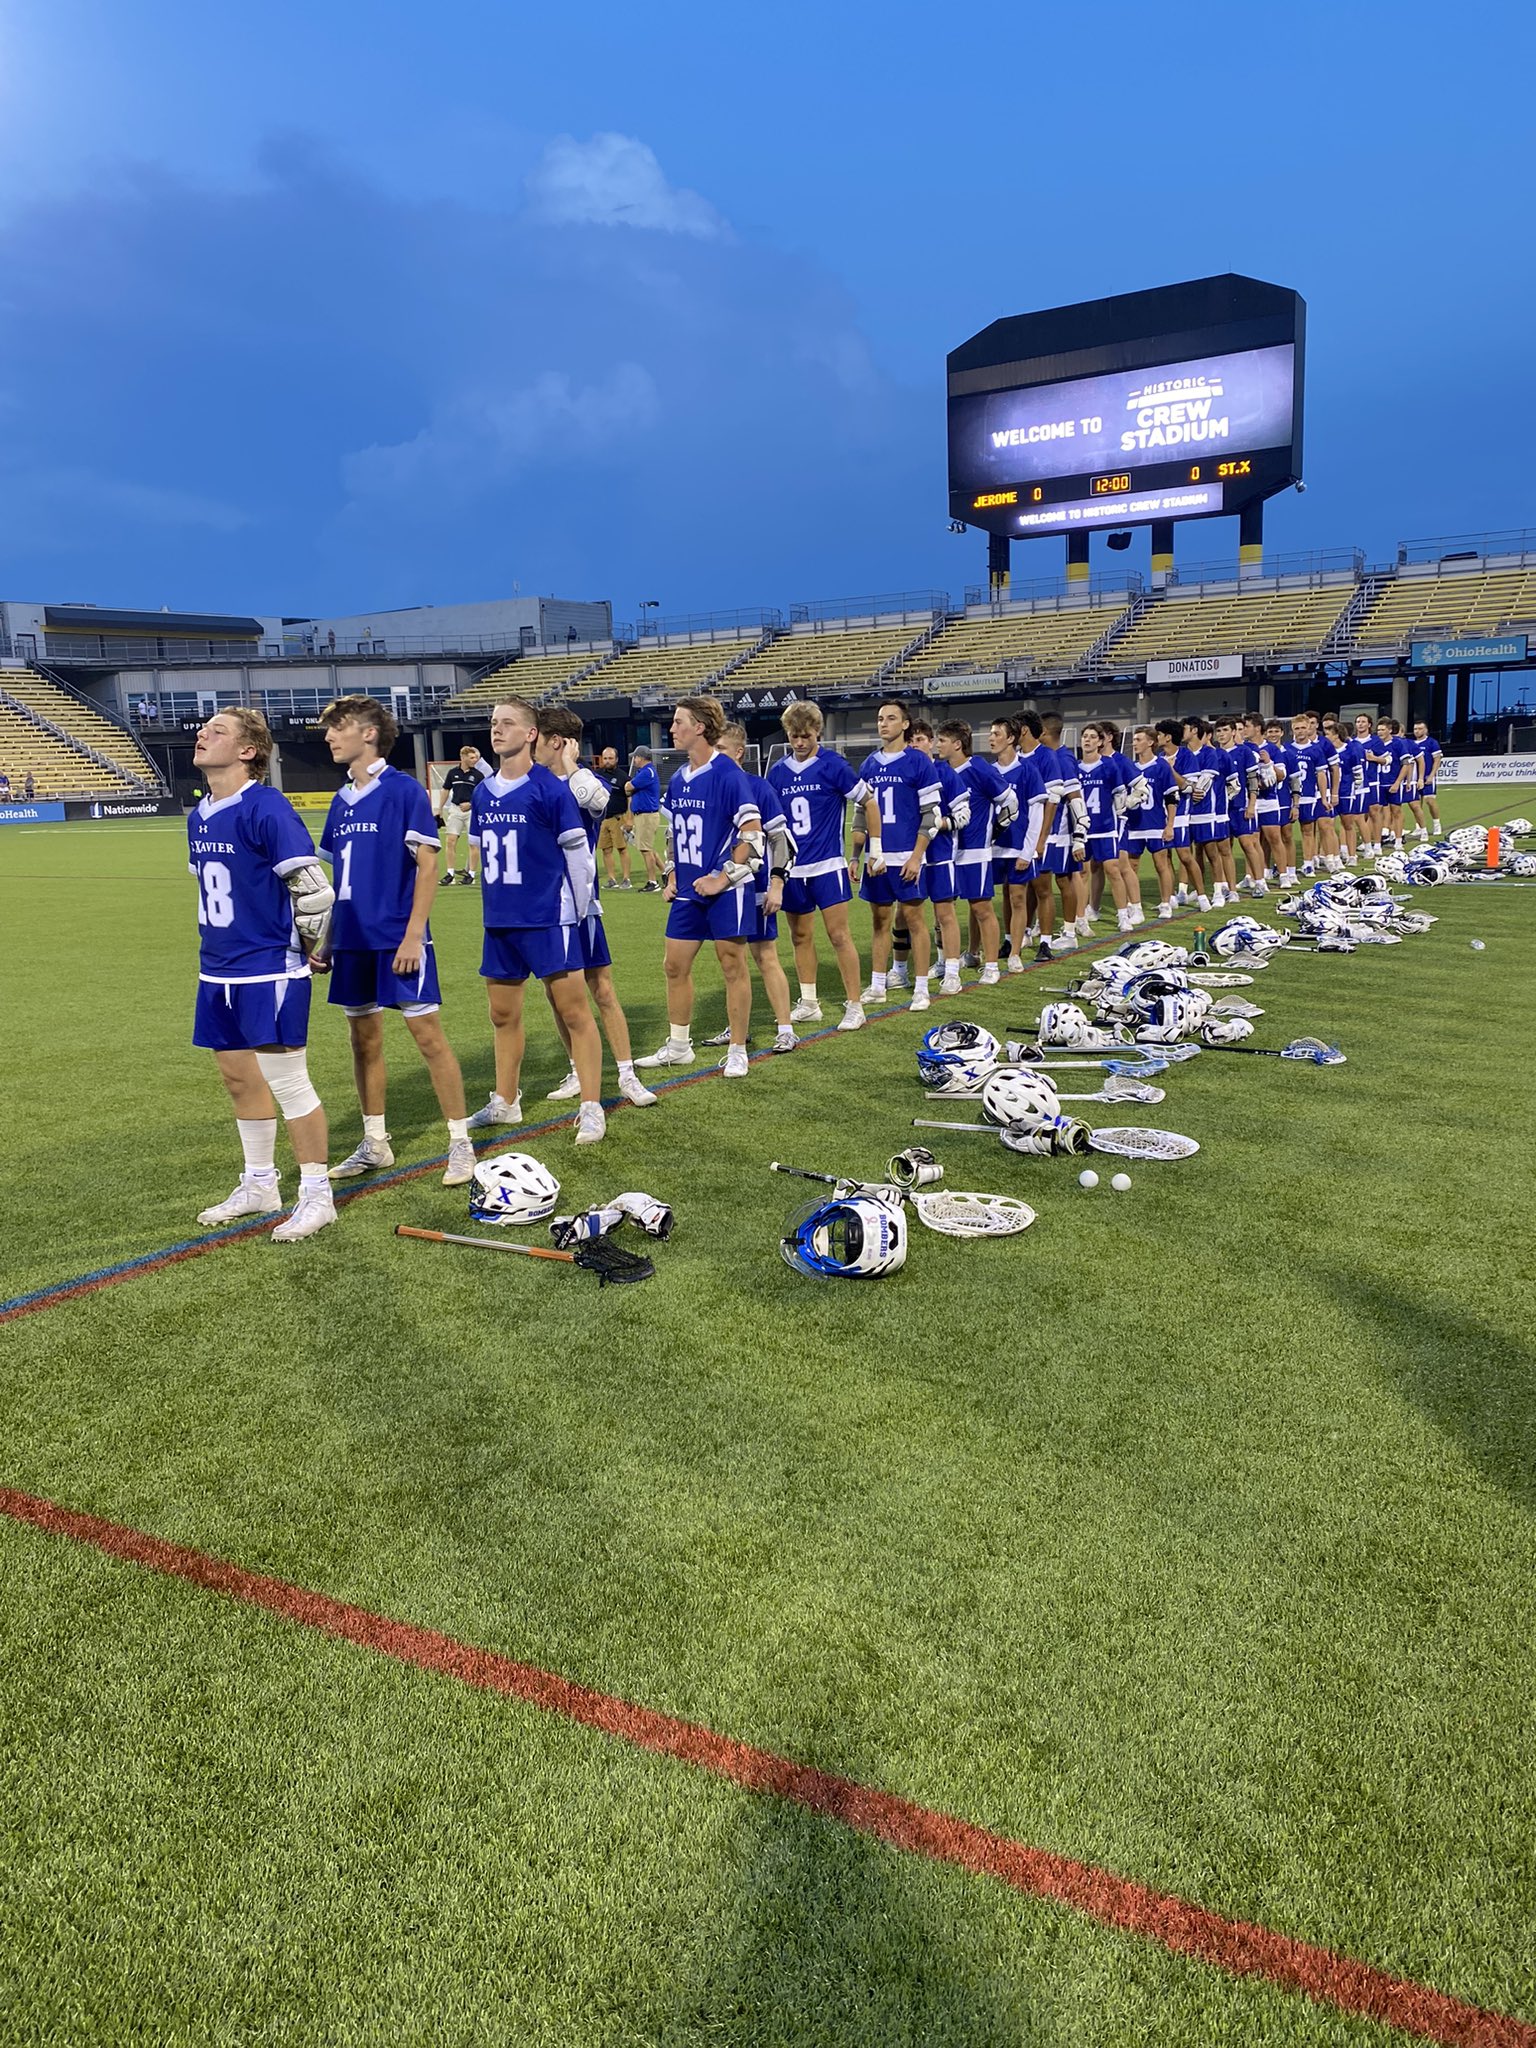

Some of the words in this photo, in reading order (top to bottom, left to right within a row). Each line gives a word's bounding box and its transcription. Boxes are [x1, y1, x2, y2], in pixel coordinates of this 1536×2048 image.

[1144, 376, 1206, 395] HISTORIC
[1137, 400, 1212, 429] CREW
[992, 421, 1075, 448] WELCOME
[1080, 417, 1102, 435] TO
[1120, 417, 1229, 451] STADIUM
[1191, 466, 1200, 480] 0
[1218, 460, 1251, 476] ST.X
[1096, 475, 1129, 492] 12:00
[974, 491, 1018, 508] JEROME
[1033, 487, 1042, 501] 0
[1019, 510, 1067, 527] WELCOME
[1069, 509, 1082, 520] TO
[1083, 503, 1128, 518] HISTORIC
[1130, 499, 1161, 513] CREW
[1162, 493, 1208, 509] STADIUM
[1445, 644, 1517, 658] OhioHealth
[289, 717, 303, 725] BUY
[1482, 761, 1507, 769] We're
[1508, 760, 1535, 768] closer
[1476, 770, 1495, 778] than
[1497, 770, 1513, 779] you
[104, 803, 158, 816] Nationwide
[790, 796, 812, 836] 9
[674, 813, 704, 868] 22
[482, 829, 522, 885] 31
[338, 840, 354, 901] 1
[879, 1213, 890, 1259] BOMBERS
